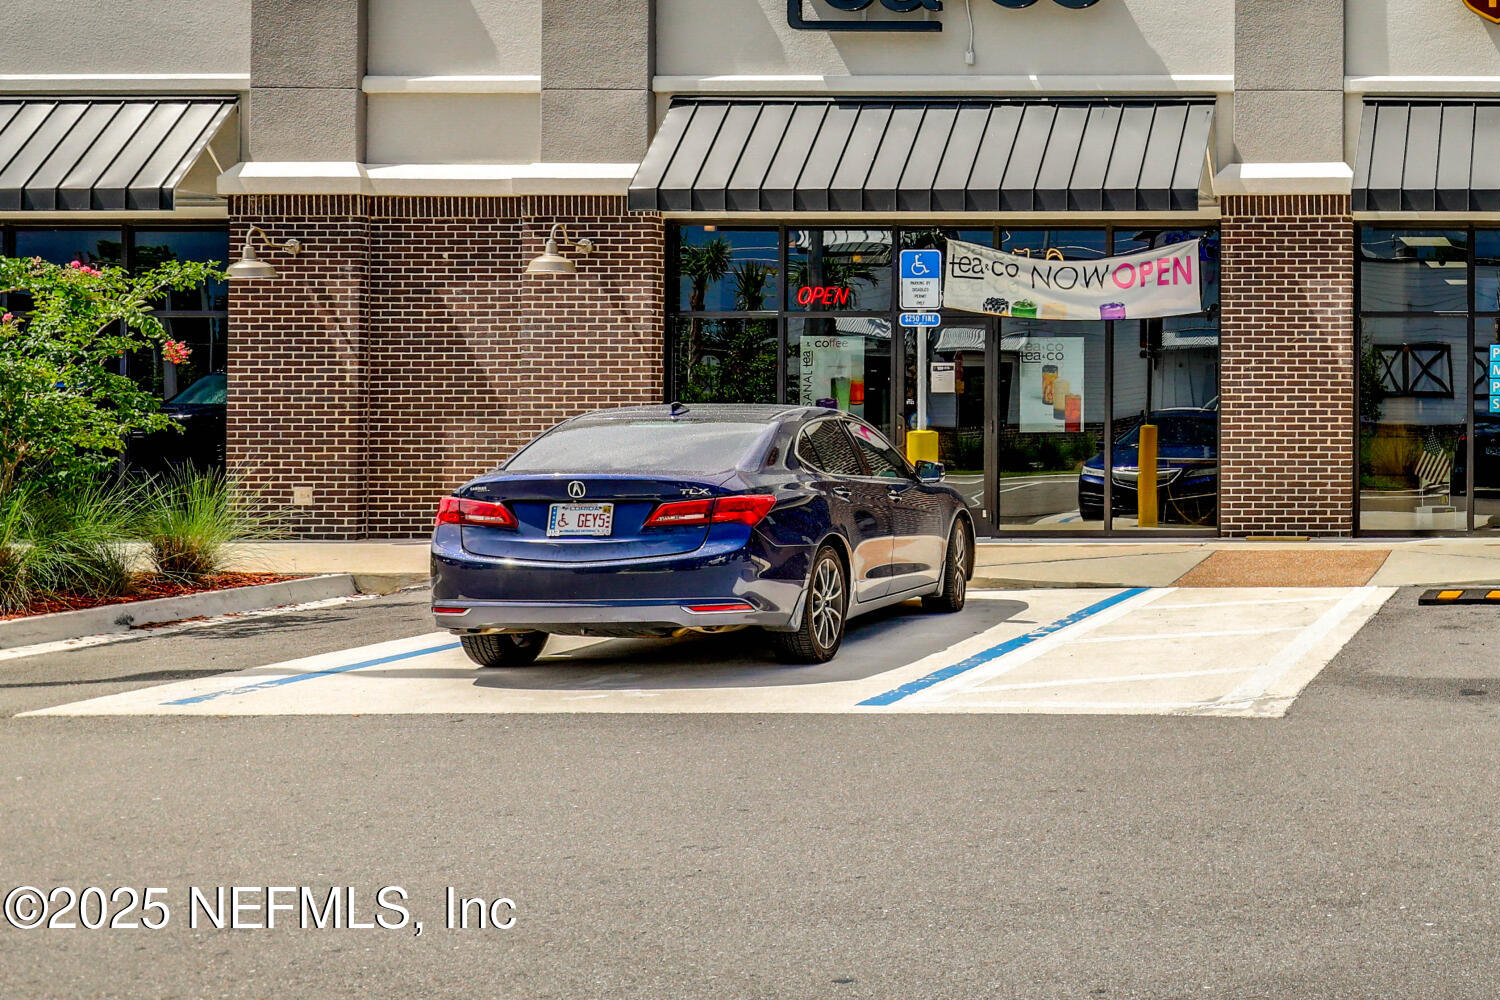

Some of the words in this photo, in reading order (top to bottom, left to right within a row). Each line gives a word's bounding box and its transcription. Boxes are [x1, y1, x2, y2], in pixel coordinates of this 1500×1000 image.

[1030, 264, 1110, 290] NOW
[1111, 255, 1192, 290] OPEN
[797, 285, 850, 305] OPEN
[802, 350, 814, 367] tea
